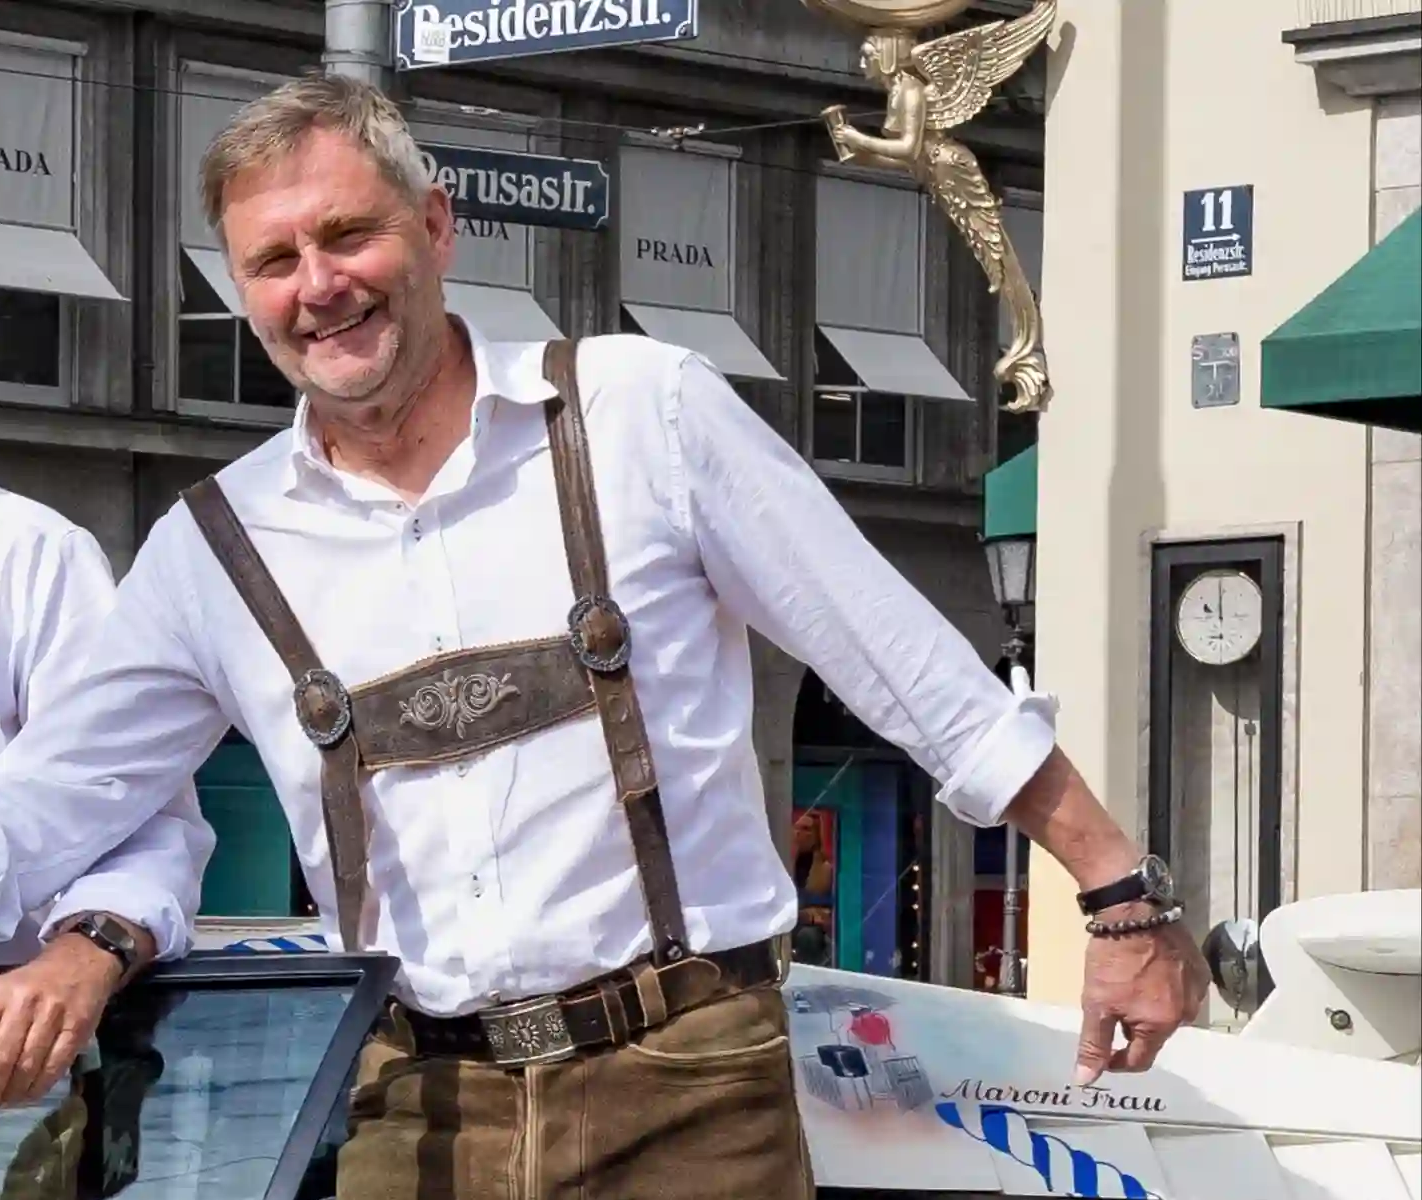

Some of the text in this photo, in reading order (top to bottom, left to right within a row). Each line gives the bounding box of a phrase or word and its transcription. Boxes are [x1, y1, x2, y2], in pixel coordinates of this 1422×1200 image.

[1200, 190, 1234, 231] 11
[450, 219, 510, 242] ADA
[636, 238, 715, 268] PRADA
[939, 1078, 1168, 1112] Maroni Frau
